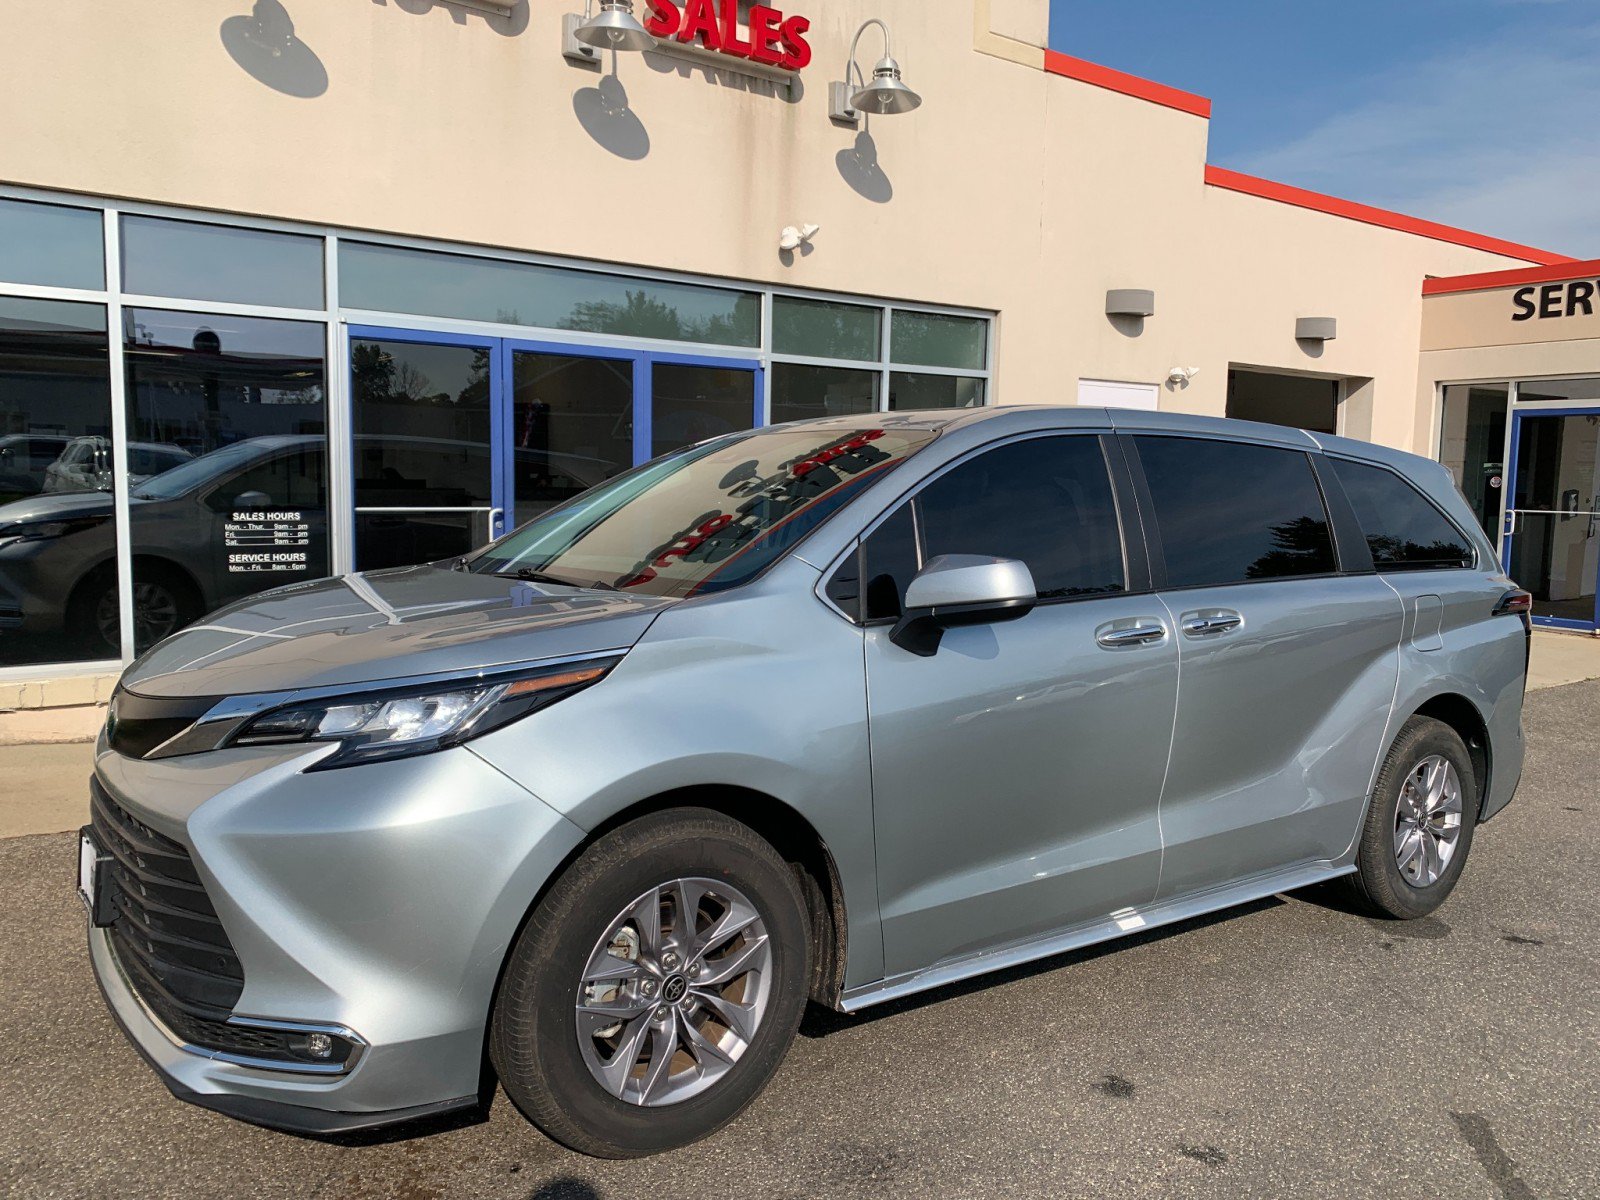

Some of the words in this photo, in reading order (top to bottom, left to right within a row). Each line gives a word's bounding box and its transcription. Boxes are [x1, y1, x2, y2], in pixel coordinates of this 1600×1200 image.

[643, 0, 812, 70] SALES
[1511, 280, 1600, 321] SER
[232, 512, 265, 520] SALES
[266, 512, 301, 520] HOURS
[228, 553, 270, 562] SERVICE
[272, 552, 306, 561] HOURS
